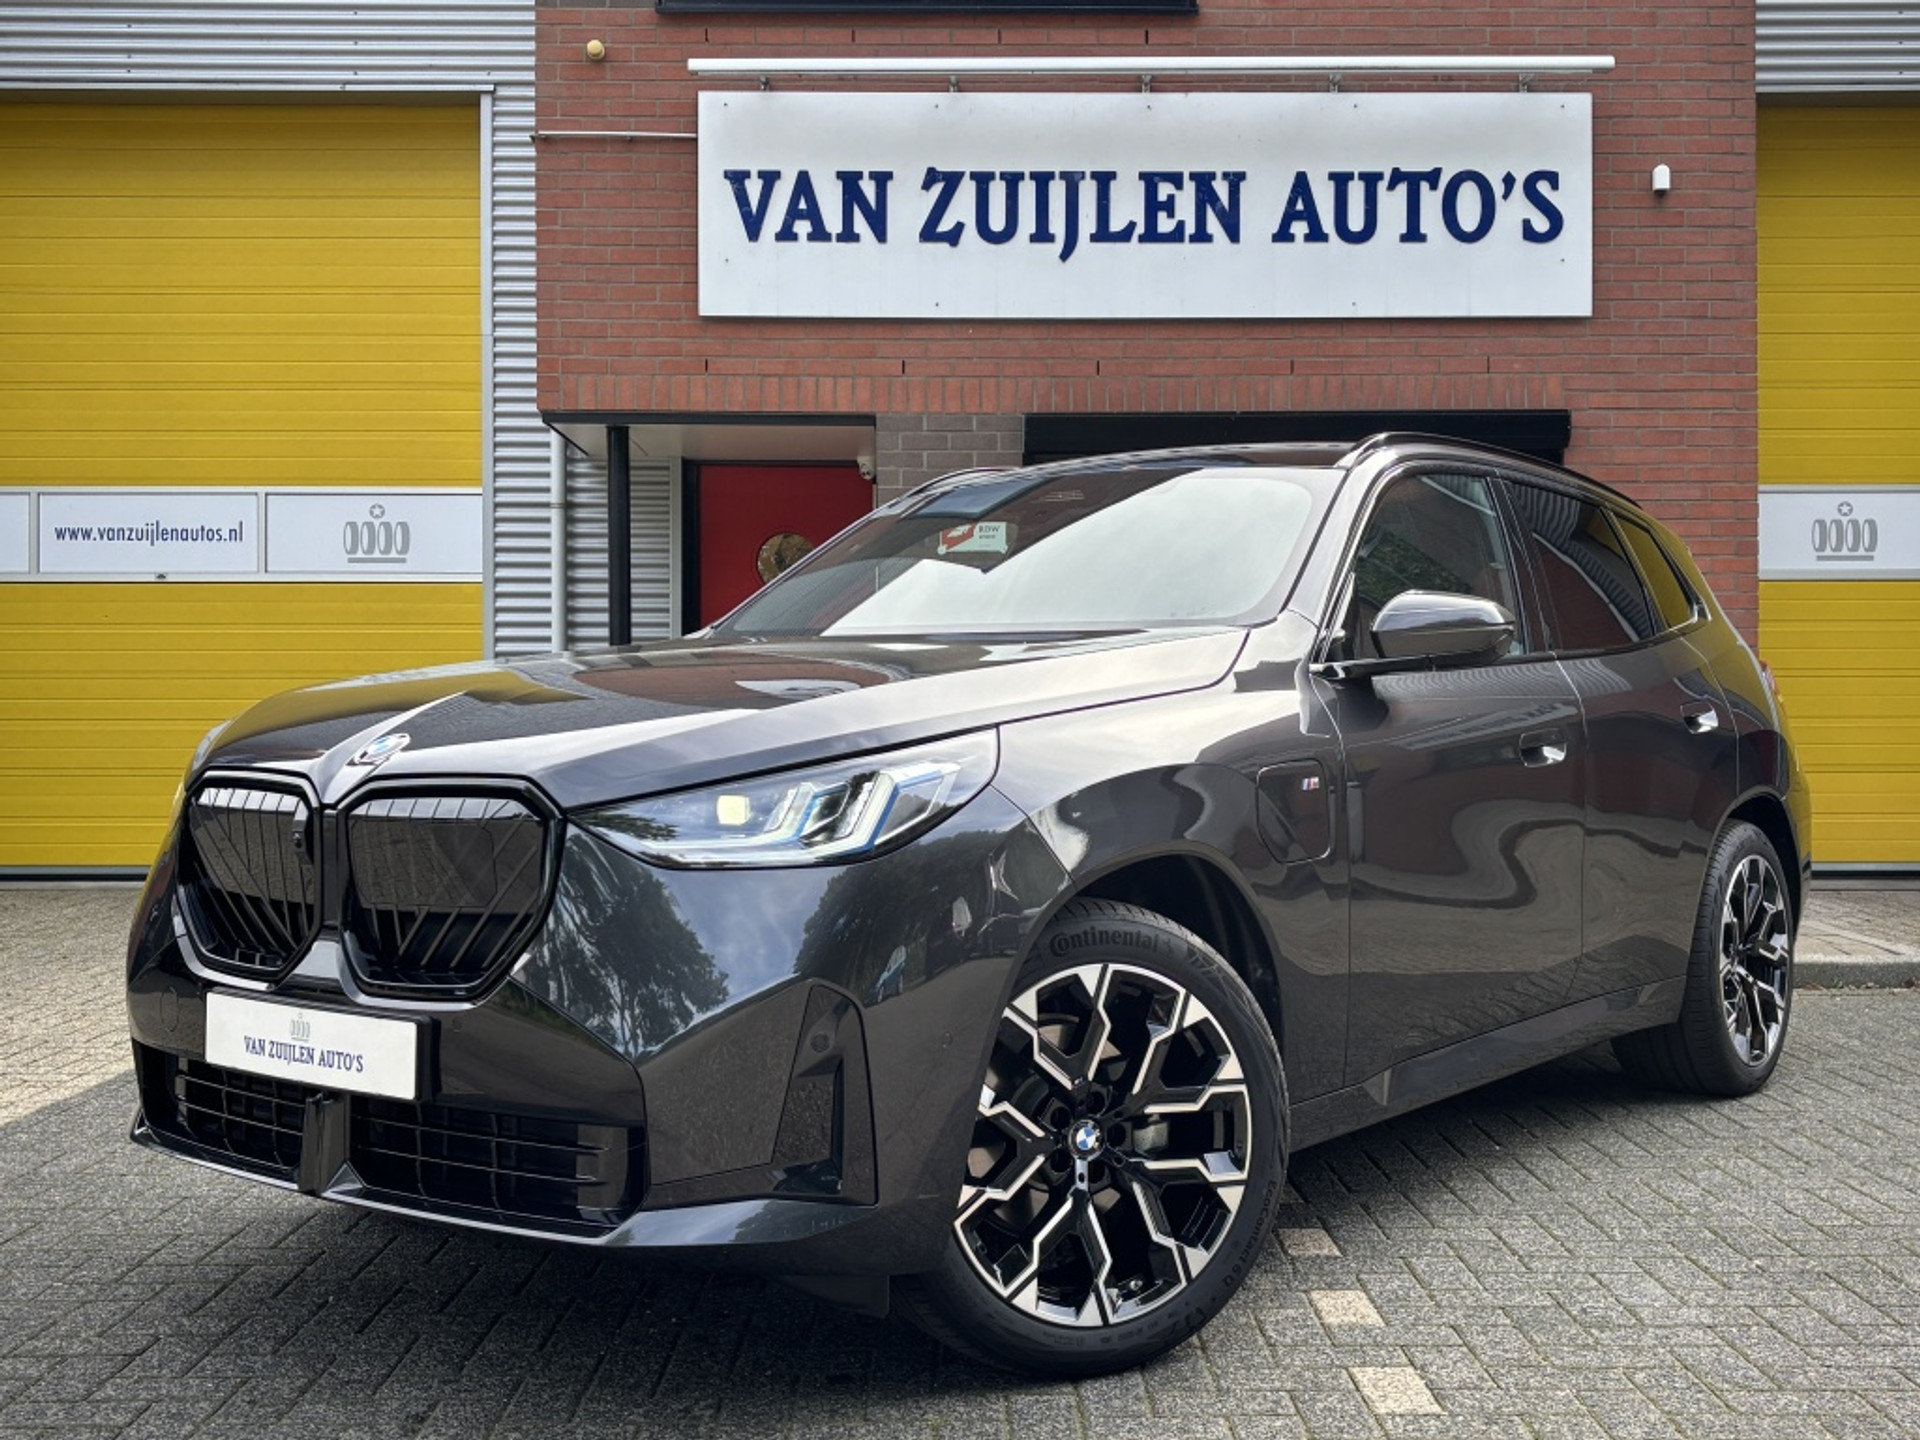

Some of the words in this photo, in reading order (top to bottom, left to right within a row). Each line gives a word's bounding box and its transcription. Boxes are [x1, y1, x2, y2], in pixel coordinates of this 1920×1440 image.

[724, 169, 893, 243] VAN
[918, 167, 1246, 261] ZUIJLEN
[1271, 167, 1564, 244] AUTO'S
[54, 520, 243, 546] www.vanzuijlenautos.nl
[1050, 925, 1158, 957] Continental
[244, 1036, 265, 1056] VAN
[268, 1041, 314, 1065] ZUIJLEN
[318, 1050, 363, 1073] AUTO'S
